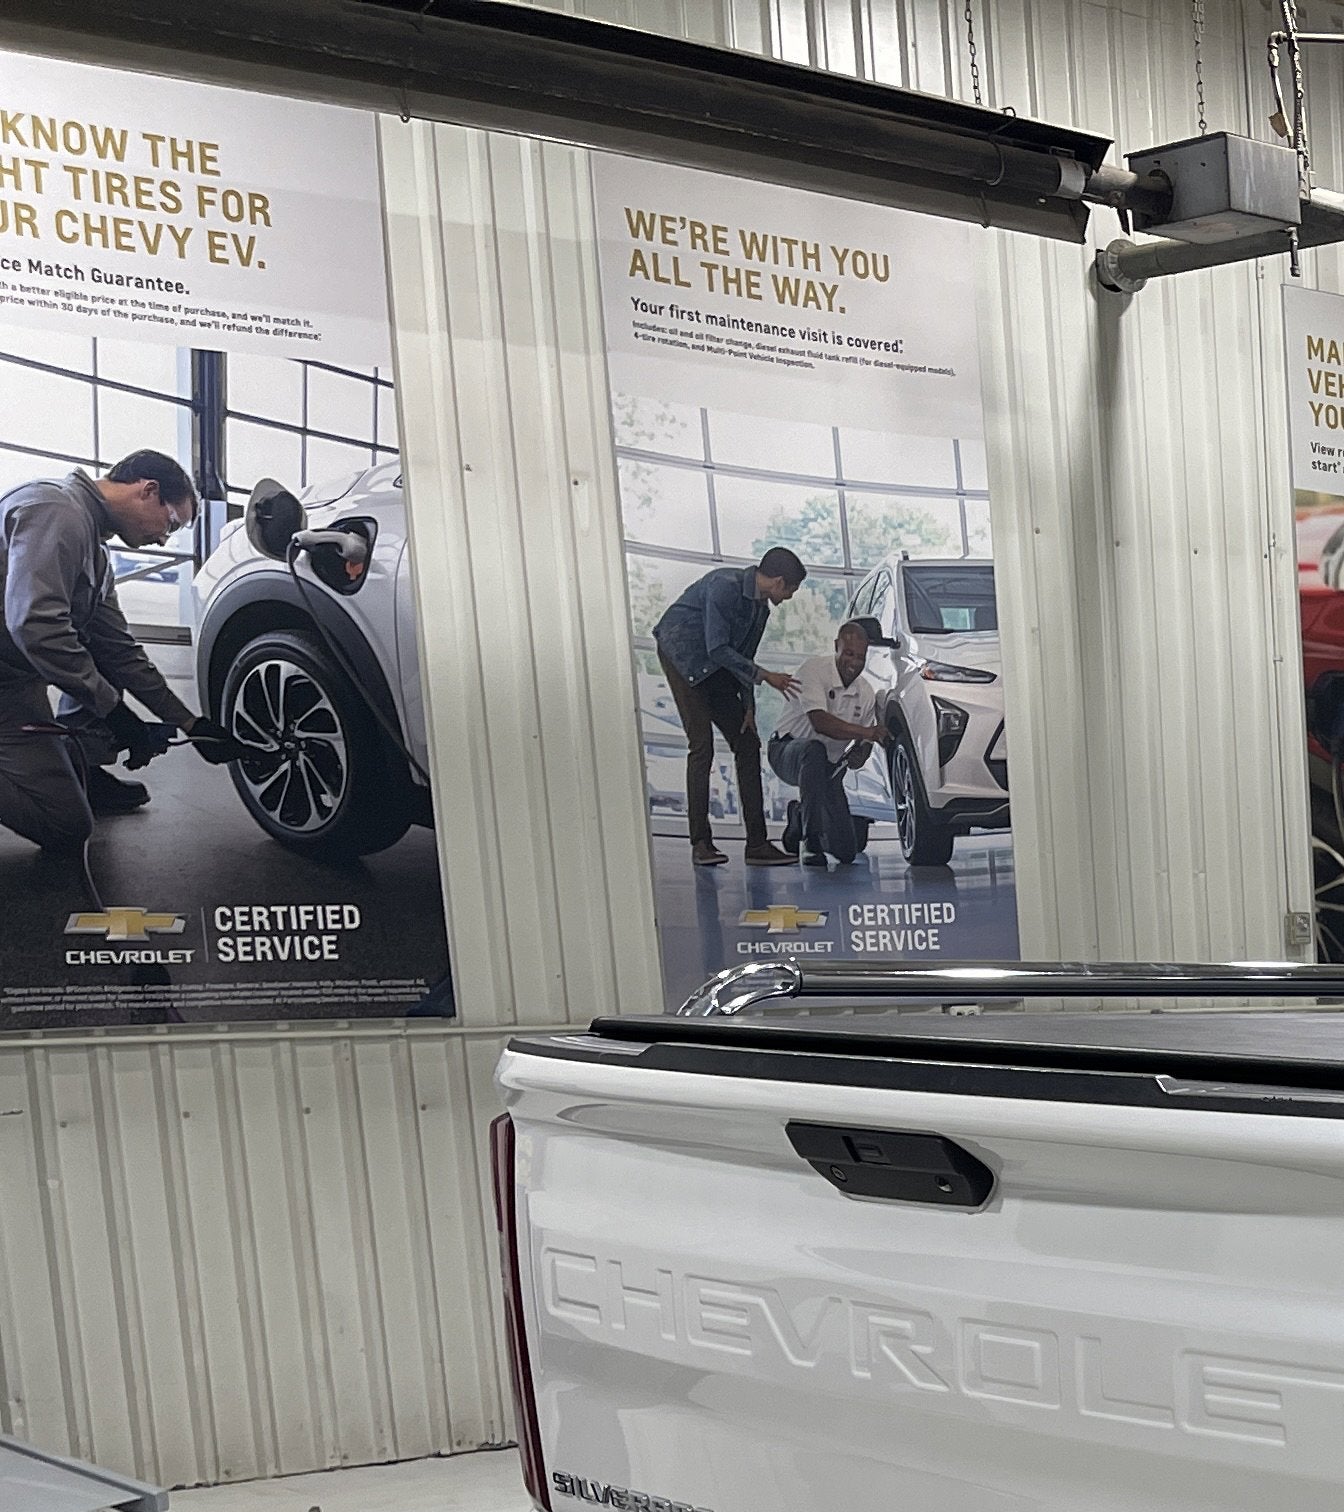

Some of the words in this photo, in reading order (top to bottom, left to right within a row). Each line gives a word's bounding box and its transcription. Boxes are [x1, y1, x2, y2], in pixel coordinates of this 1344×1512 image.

[0, 110, 128, 162] KNOW
[143, 133, 220, 176] THE
[63, 164, 183, 214] TIRES
[197, 185, 272, 227] FOR
[55, 209, 192, 259] CHEVY
[207, 231, 266, 269] EV.
[738, 229, 822, 273] WITH
[831, 244, 891, 283] YOU
[28, 259, 85, 281] Match
[91, 268, 190, 295] Guarantee.
[629, 249, 692, 288] ALL
[701, 261, 763, 301] THE
[771, 273, 846, 314] WAY.
[27, 299, 58, 310] within
[61, 302, 74, 312] 30
[76, 305, 98, 317] days
[113, 309, 129, 319] the
[179, 318, 197, 327] and
[222, 323, 253, 334] refund
[91, 296, 116, 306] price
[131, 299, 146, 308] the
[149, 302, 169, 312] time
[231, 312, 248, 321] and
[273, 317, 301, 327] match
[631, 296, 665, 316] Your
[668, 303, 702, 324] first
[705, 313, 796, 339] maintenance
[799, 327, 829, 345] visit
[832, 331, 843, 346] is
[1310, 441, 1335, 457] View
[214, 905, 361, 932] CERTIFIED
[848, 902, 955, 926] CERTIFIED
[65, 949, 195, 965] CHEVROLET
[217, 934, 340, 963] SERVICE
[737, 941, 834, 954] CHEVROLET
[850, 929, 941, 952] SERVICE
